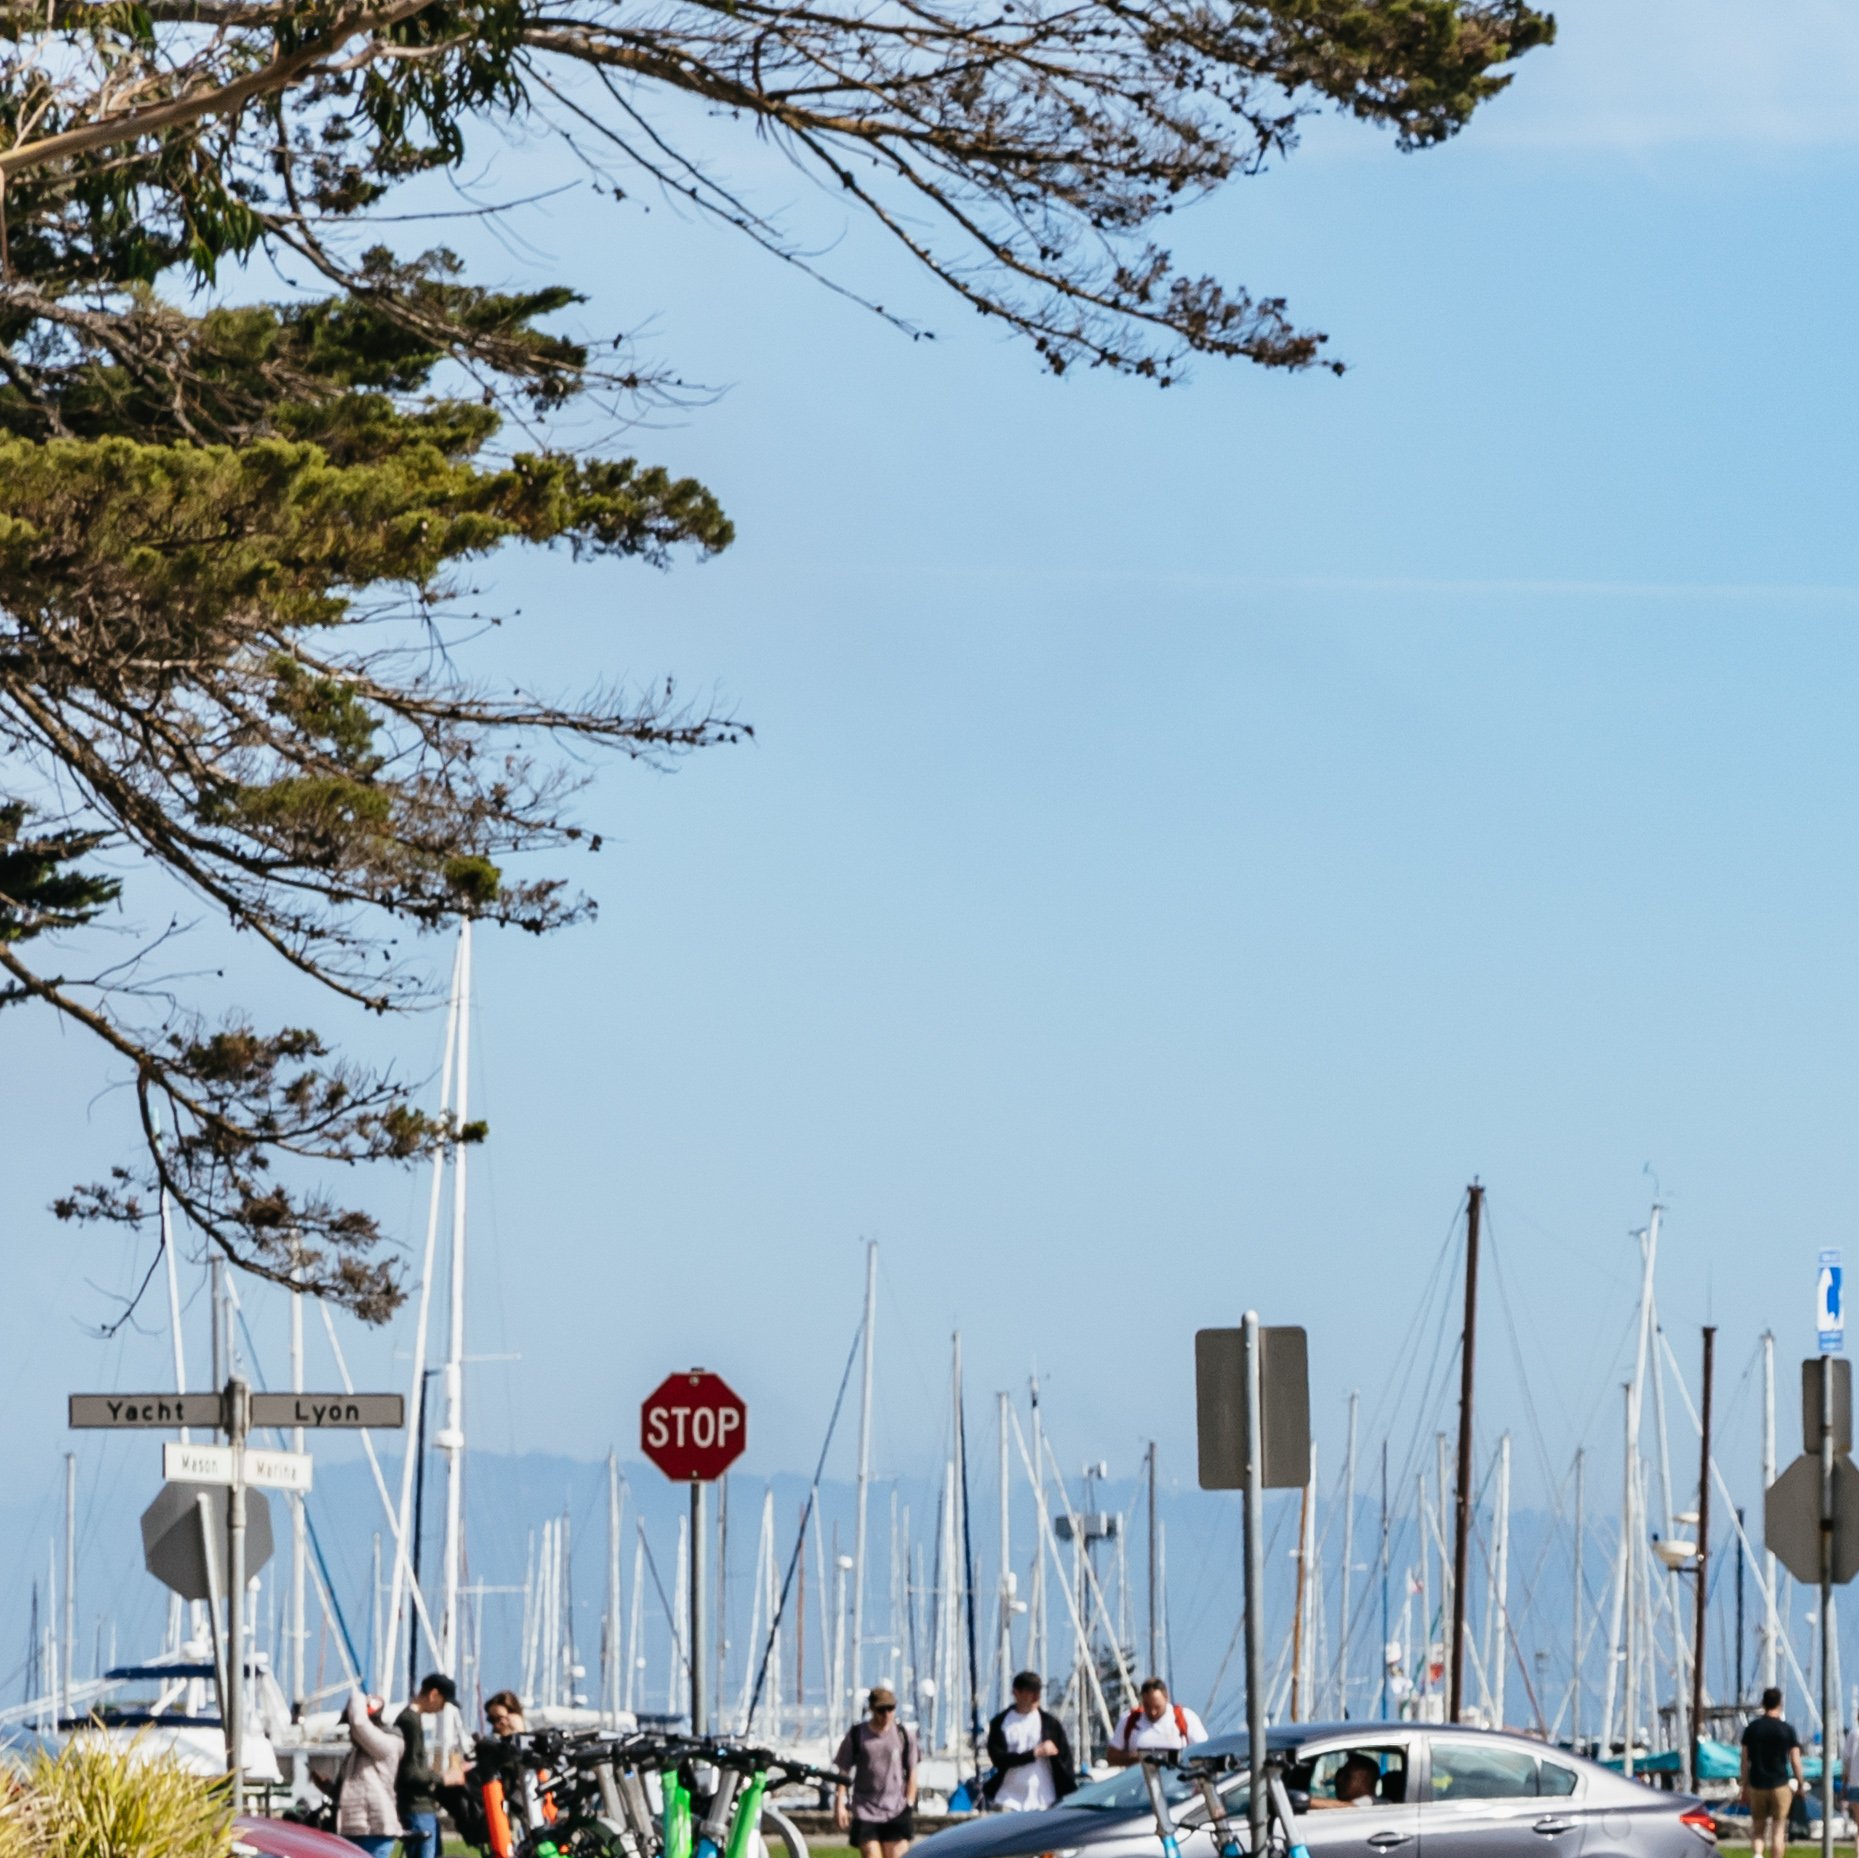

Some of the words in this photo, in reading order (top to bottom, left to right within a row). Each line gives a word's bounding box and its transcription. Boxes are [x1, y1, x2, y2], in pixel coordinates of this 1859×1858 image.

[107, 1400, 185, 1422] Yacht
[295, 1400, 360, 1426] Lyon
[647, 1405, 741, 1448] STOP
[181, 1455, 218, 1474] Mason
[255, 1460, 297, 1482] Marina
